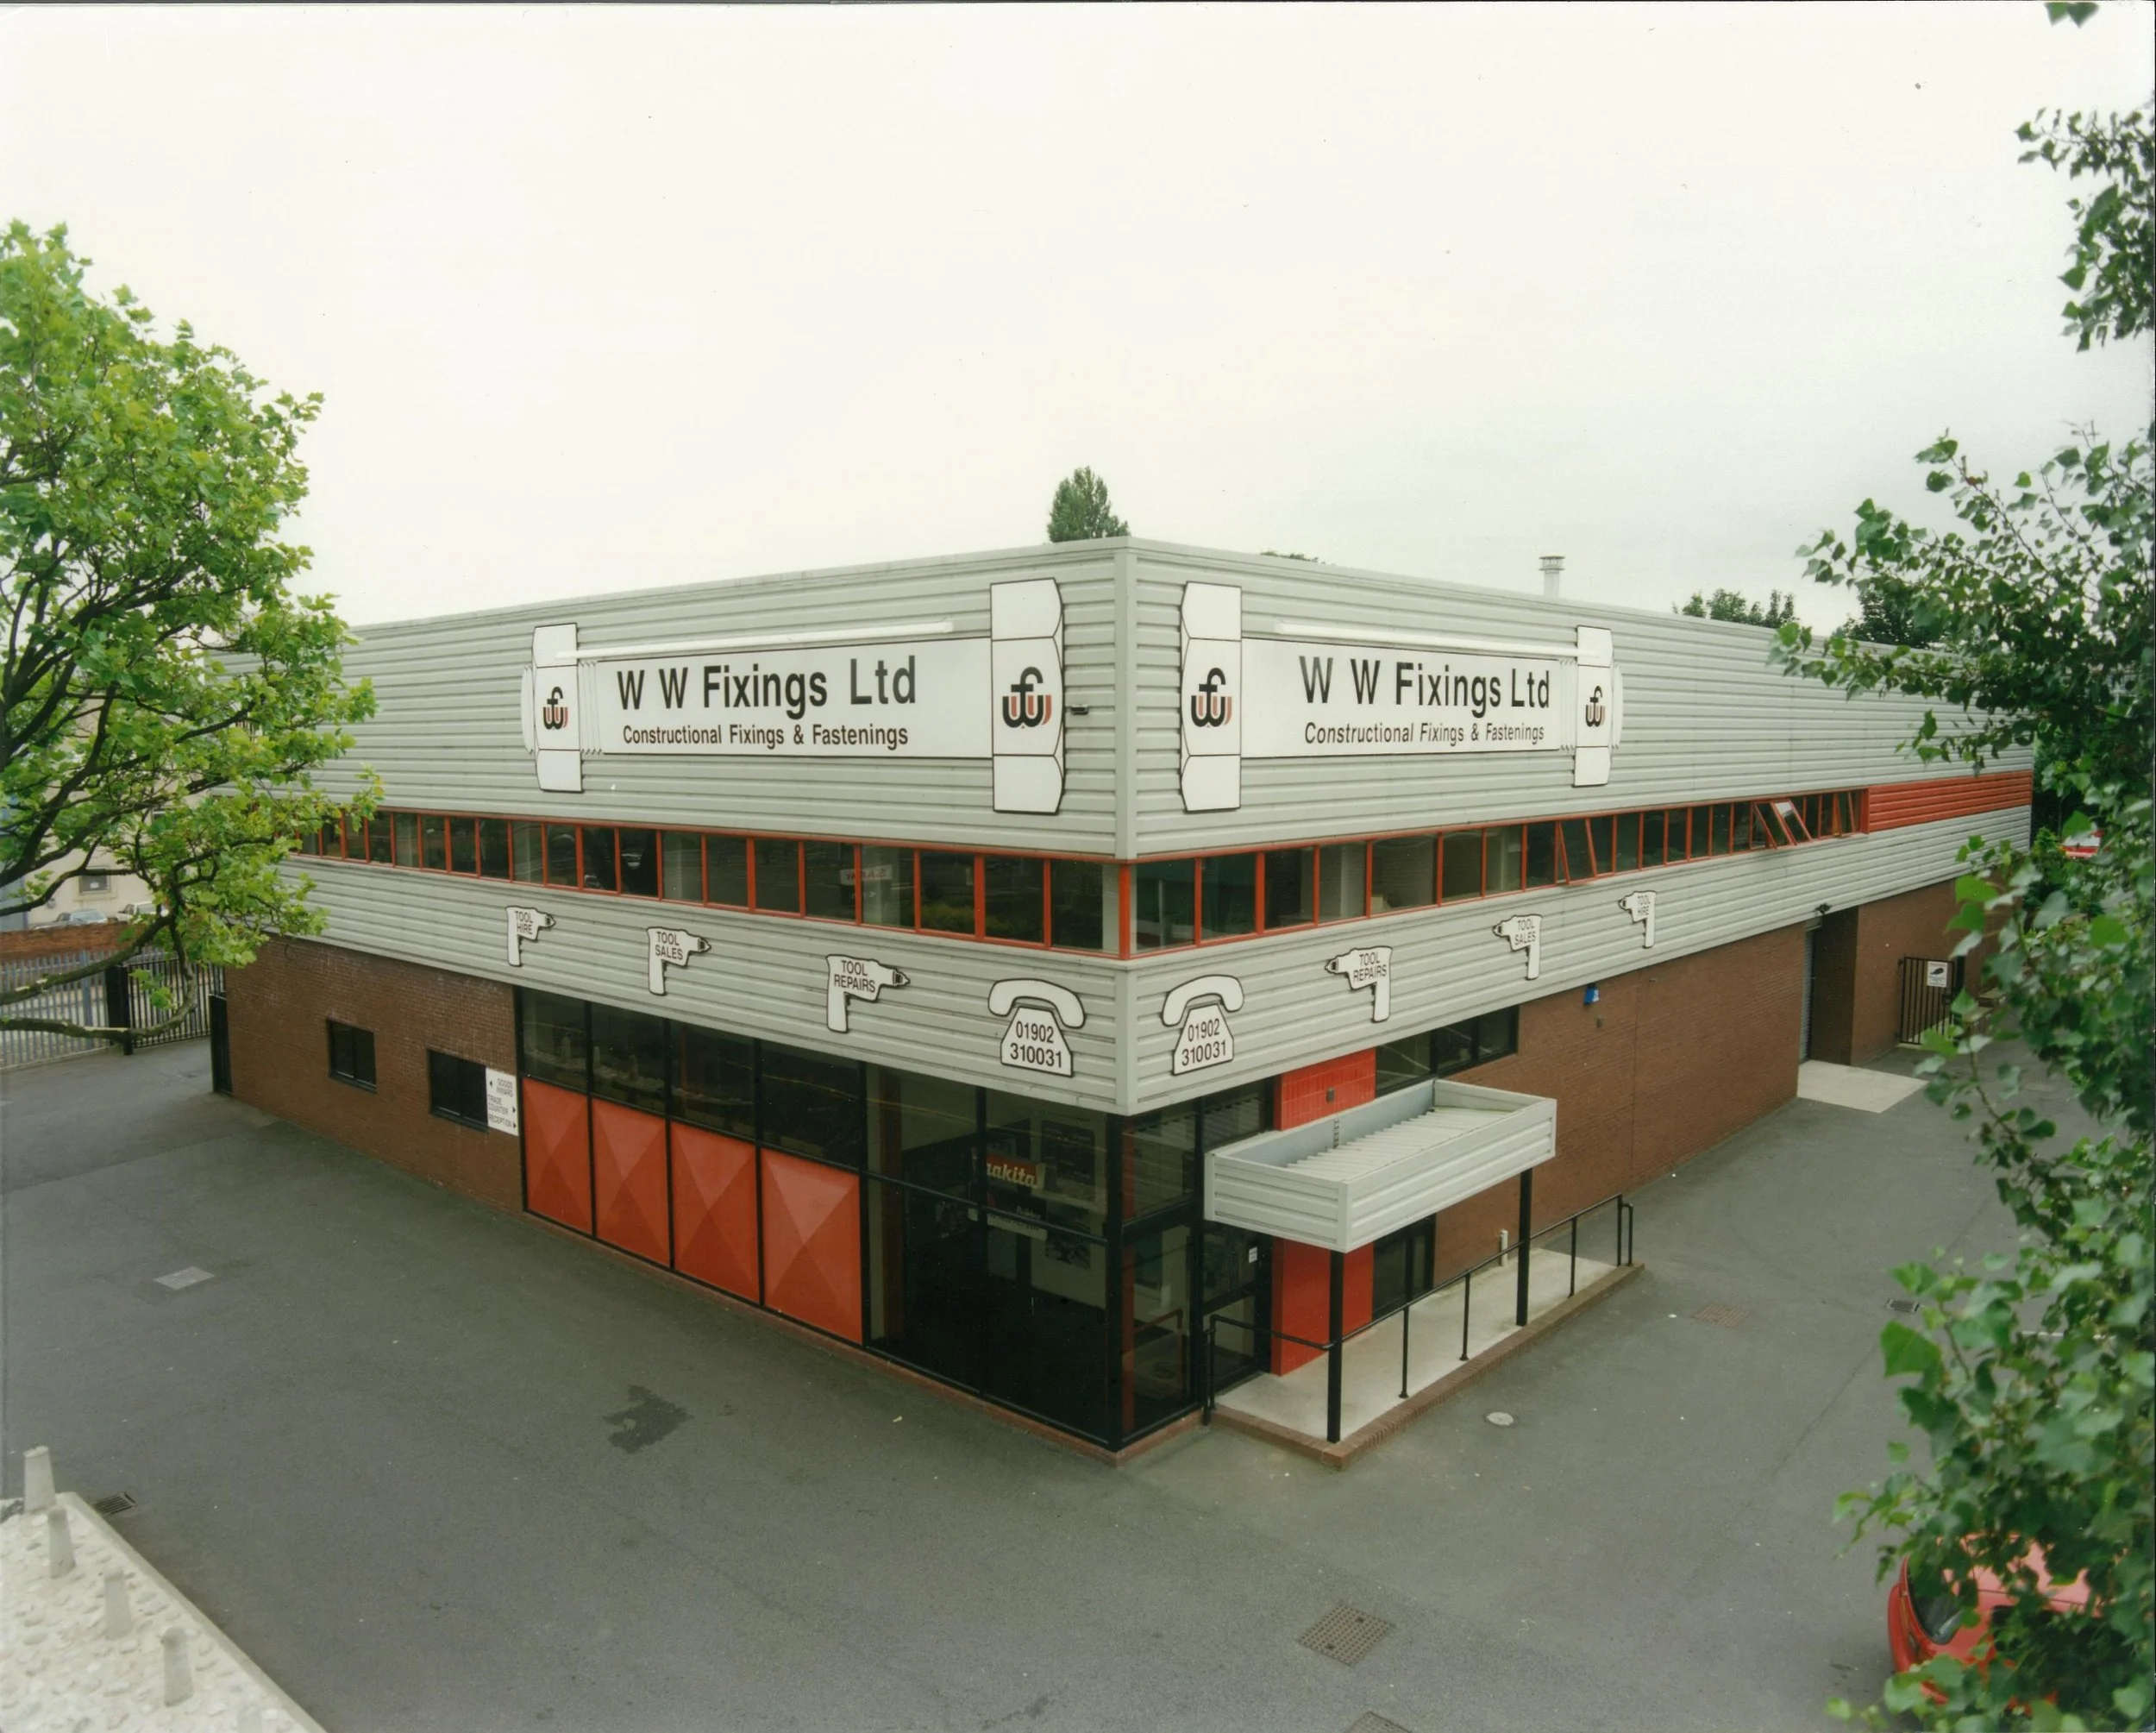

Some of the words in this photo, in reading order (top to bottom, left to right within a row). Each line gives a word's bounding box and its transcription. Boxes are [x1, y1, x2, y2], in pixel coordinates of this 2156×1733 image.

[617, 669, 645, 710] W
[659, 667, 688, 709] W
[703, 663, 828, 720] Fixings
[850, 655, 916, 705] Ltd
[1299, 656, 1333, 704] W
[1350, 658, 1381, 705] W
[1395, 662, 1501, 719] Fixings
[1511, 668, 1550, 708] Ltd
[624, 725, 722, 744] Constructional
[730, 724, 785, 750] Fixings
[793, 725, 805, 744] &
[812, 724, 909, 750] Fastenings
[1305, 721, 1413, 744] Constructional
[1420, 722, 1464, 746] Fixings
[1470, 723, 1480, 741] &
[1485, 722, 1545, 745] Fastenings
[1637, 895, 1651, 906] TOOL
[515, 911, 533, 924] TOOL
[1637, 906, 1650, 916] HIRE
[516, 922, 533, 934] HIRE
[1517, 919, 1535, 930] TOOL
[656, 931, 680, 946] TOOL
[1514, 931, 1536, 945] SALES
[655, 945, 683, 960] SALES
[1358, 951, 1381, 966] TOOL
[841, 960, 868, 976] TOOL
[1353, 964, 1388, 983] REPAIRS
[834, 974, 876, 993] REPAIRS
[1015, 1020, 1054, 1043] 01902
[1188, 1017, 1220, 1042] 01902
[1010, 1042, 1062, 1068] 310031
[1181, 1040, 1226, 1066] 310031
[487, 1094, 502, 1105] TRADE
[488, 1102, 509, 1115] COUNTER
[488, 1113, 512, 1127] RECEPTION
